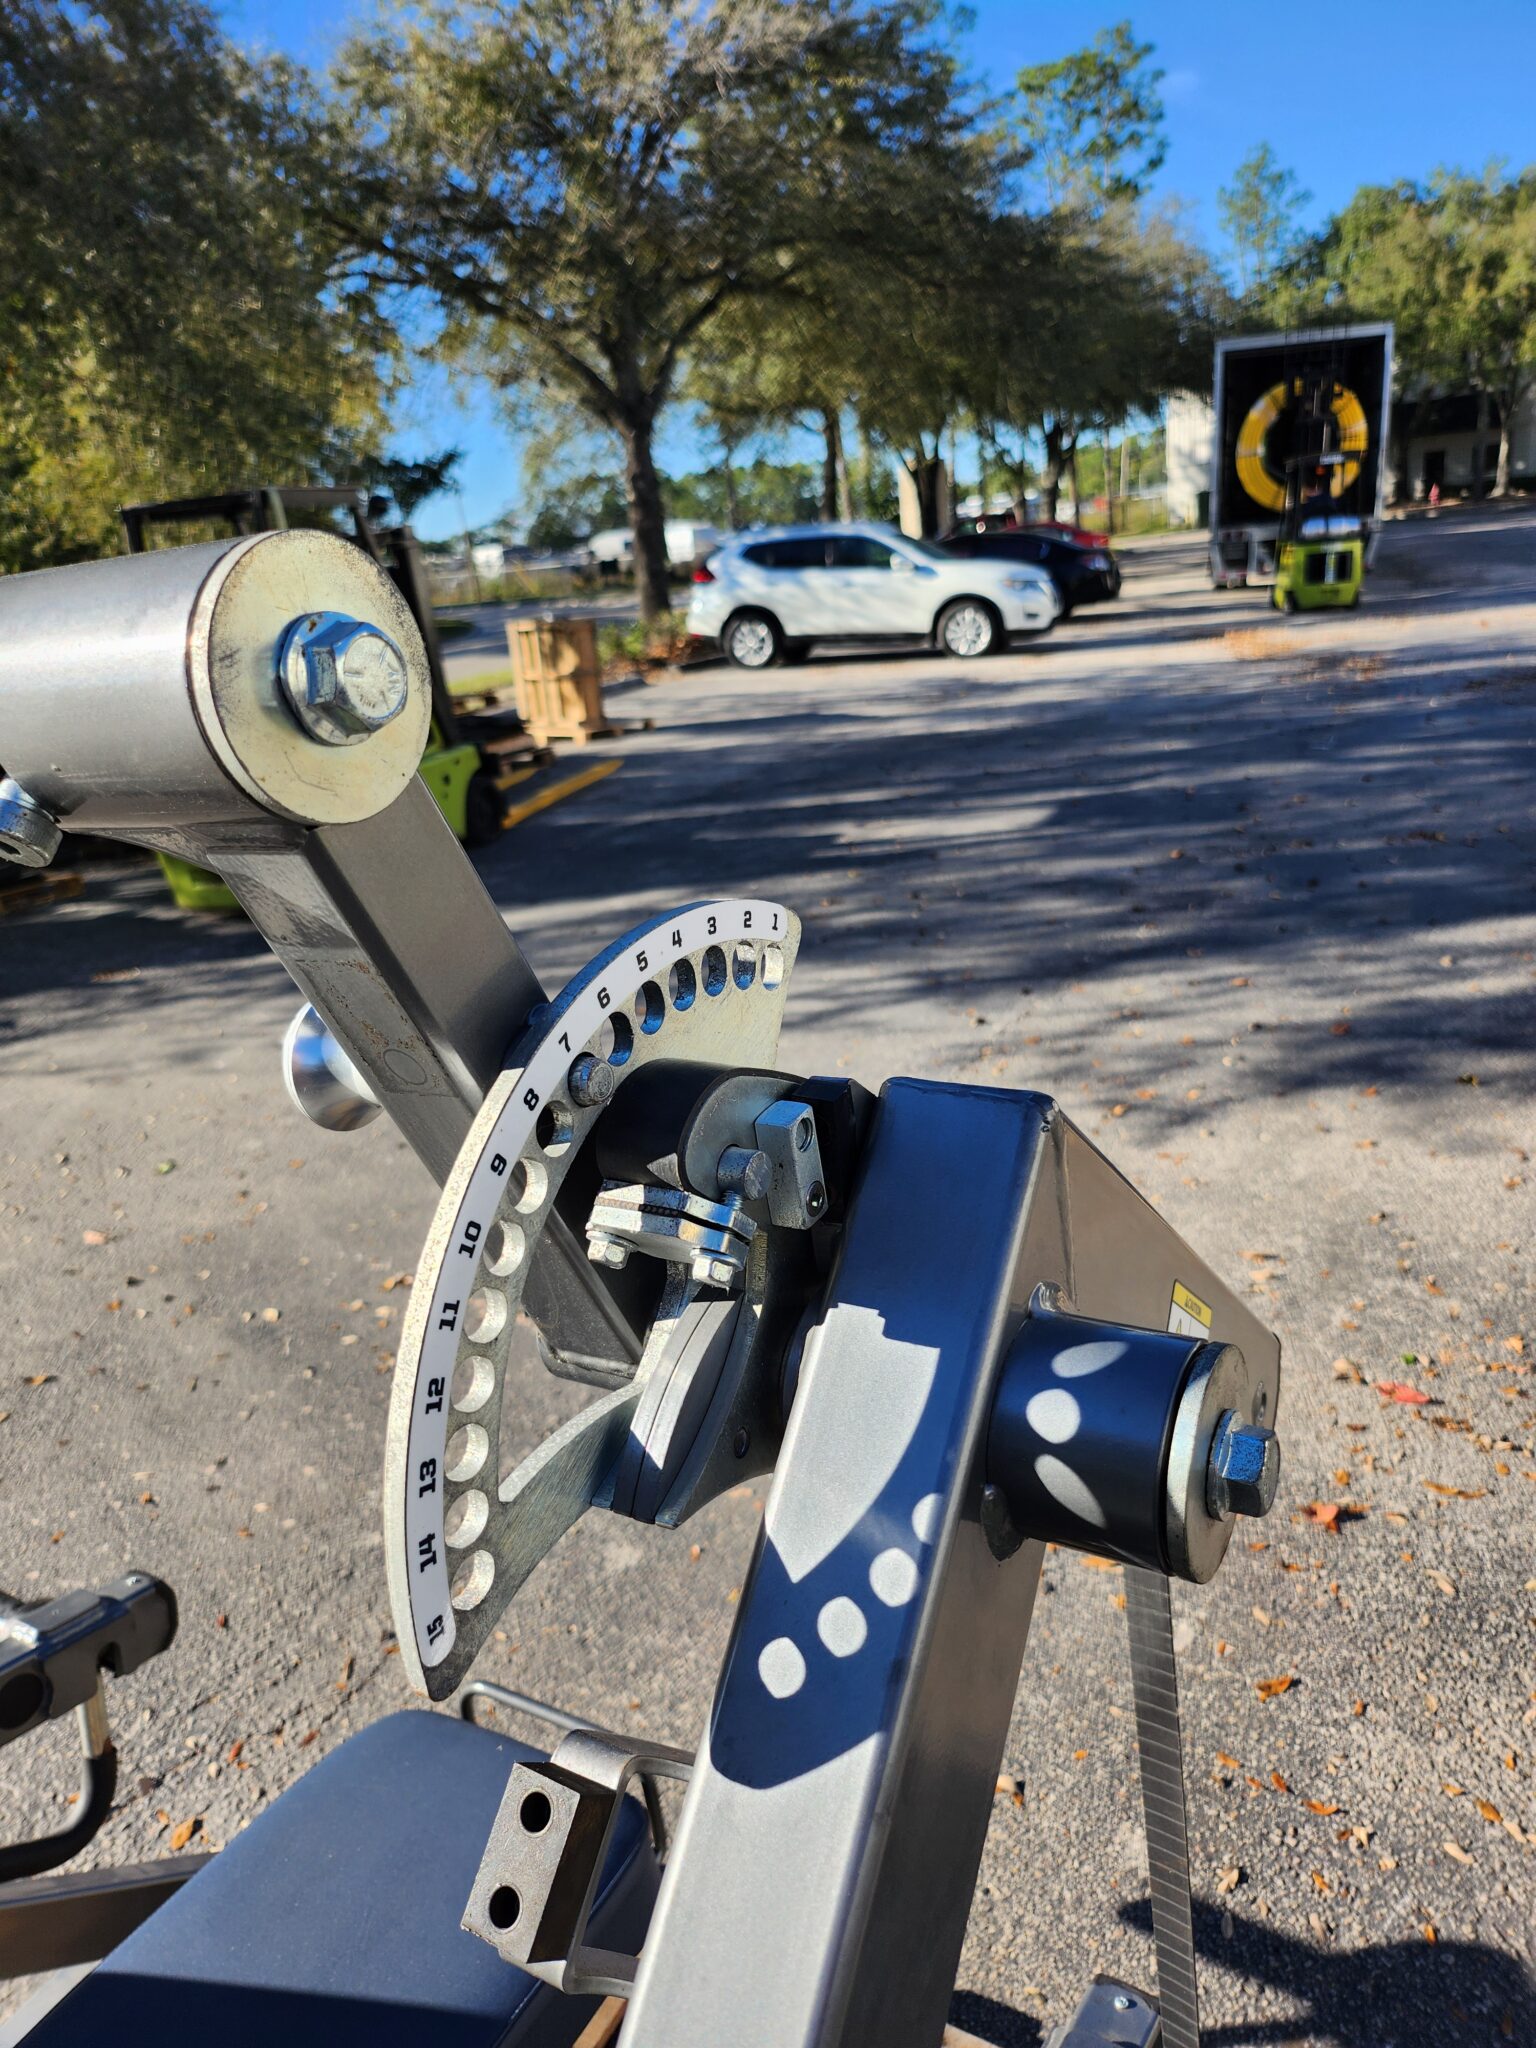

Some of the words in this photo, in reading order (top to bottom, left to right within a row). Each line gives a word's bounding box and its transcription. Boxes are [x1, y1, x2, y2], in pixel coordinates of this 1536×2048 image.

[707, 916, 717, 935] 3
[743, 910, 752, 929] 2
[771, 913, 778, 931] 1
[672, 929, 682, 948] 4
[636, 951, 648, 972] 5
[597, 987, 610, 1009] 6
[558, 1032, 571, 1053] 7
[523, 1088, 539, 1110] 8
[490, 1153, 507, 1176] 9
[458, 1220, 482, 1259] 10
[439, 1300, 460, 1331] 11
[425, 1377, 445, 1414] 12
[419, 1458, 436, 1498] 13
[419, 1533, 437, 1573] 14
[427, 1615, 444, 1646] 15
